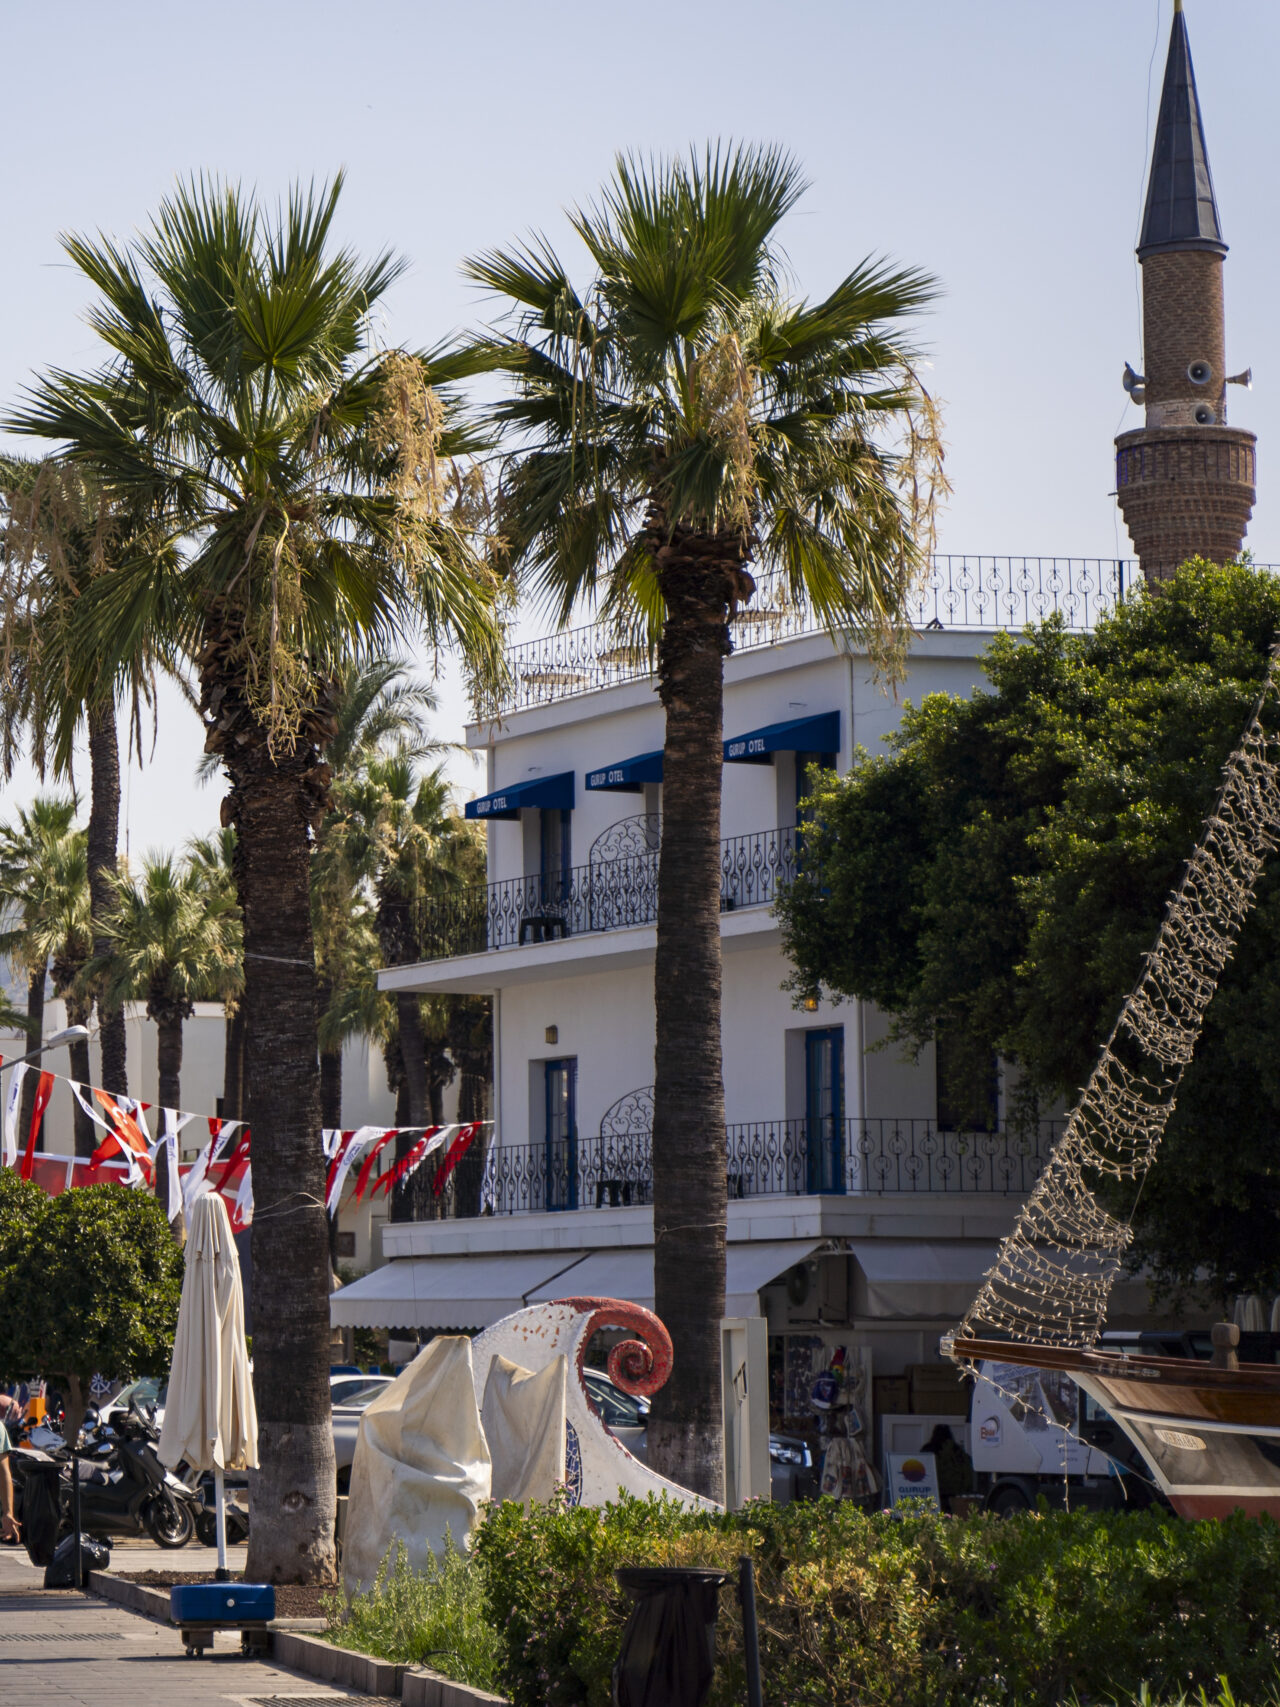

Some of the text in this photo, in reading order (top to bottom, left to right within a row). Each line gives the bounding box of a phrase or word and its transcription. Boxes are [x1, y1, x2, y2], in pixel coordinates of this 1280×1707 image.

[729, 738, 765, 757] GURUP OTEL
[590, 769, 624, 787] GURUP OTEL
[476, 796, 507, 814] GURUP OTEL
[899, 1486, 931, 1494] GURUP
